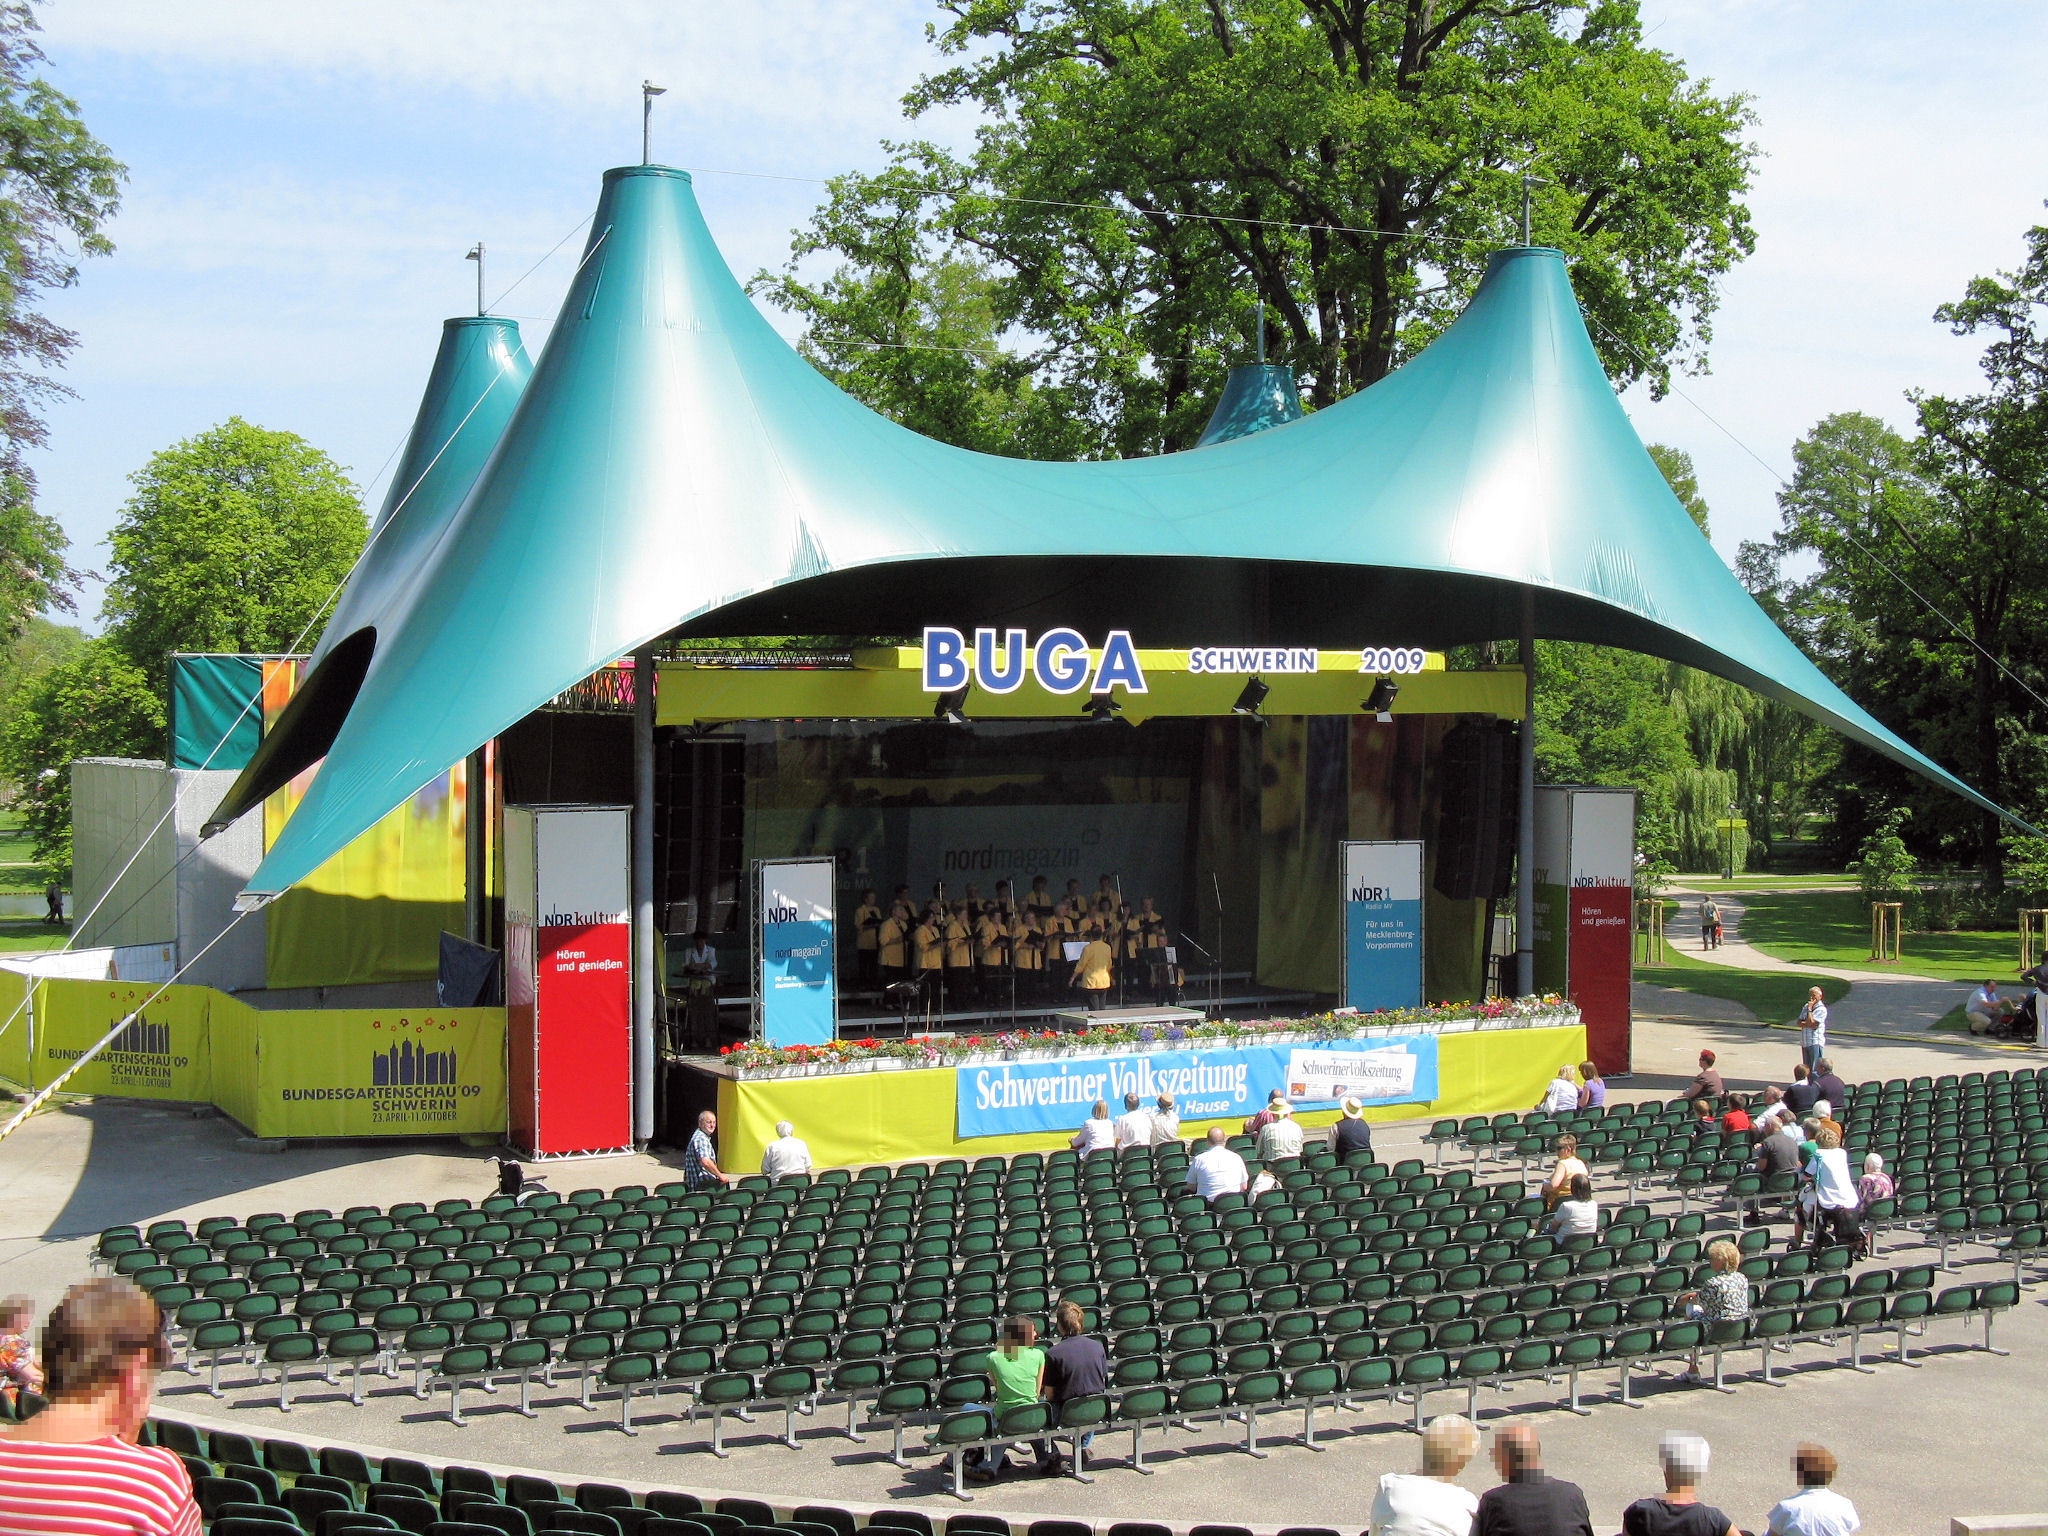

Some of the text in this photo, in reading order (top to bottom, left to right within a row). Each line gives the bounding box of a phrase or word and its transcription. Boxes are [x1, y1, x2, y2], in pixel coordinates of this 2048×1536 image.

[923, 627, 1425, 694] BUGA SCHWERIN 2009
[945, 844, 1080, 874] nordmagazin
[1574, 877, 1593, 888] NDR
[1581, 907, 1602, 916] Hören
[544, 913, 573, 927] NDR
[574, 911, 621, 926] kultur
[1366, 920, 1378, 928] Für
[1397, 920, 1404, 928] in
[1581, 916, 1626, 927] und genießen
[1366, 931, 1416, 940] Mecklenburg-
[775, 945, 822, 959] nordmagazin
[1366, 941, 1413, 950] Vorpommern
[556, 950, 585, 960] Hören
[556, 959, 623, 973] und genießen
[111, 1064, 171, 1078] SCHWERIN
[1301, 1059, 1402, 1081] Schweriner Volkszeitung
[976, 1055, 1249, 1110] Schweriner Volkszeitung
[372, 1099, 457, 1112] SCHWERIN
[1183, 1100, 1230, 1114] Hause
